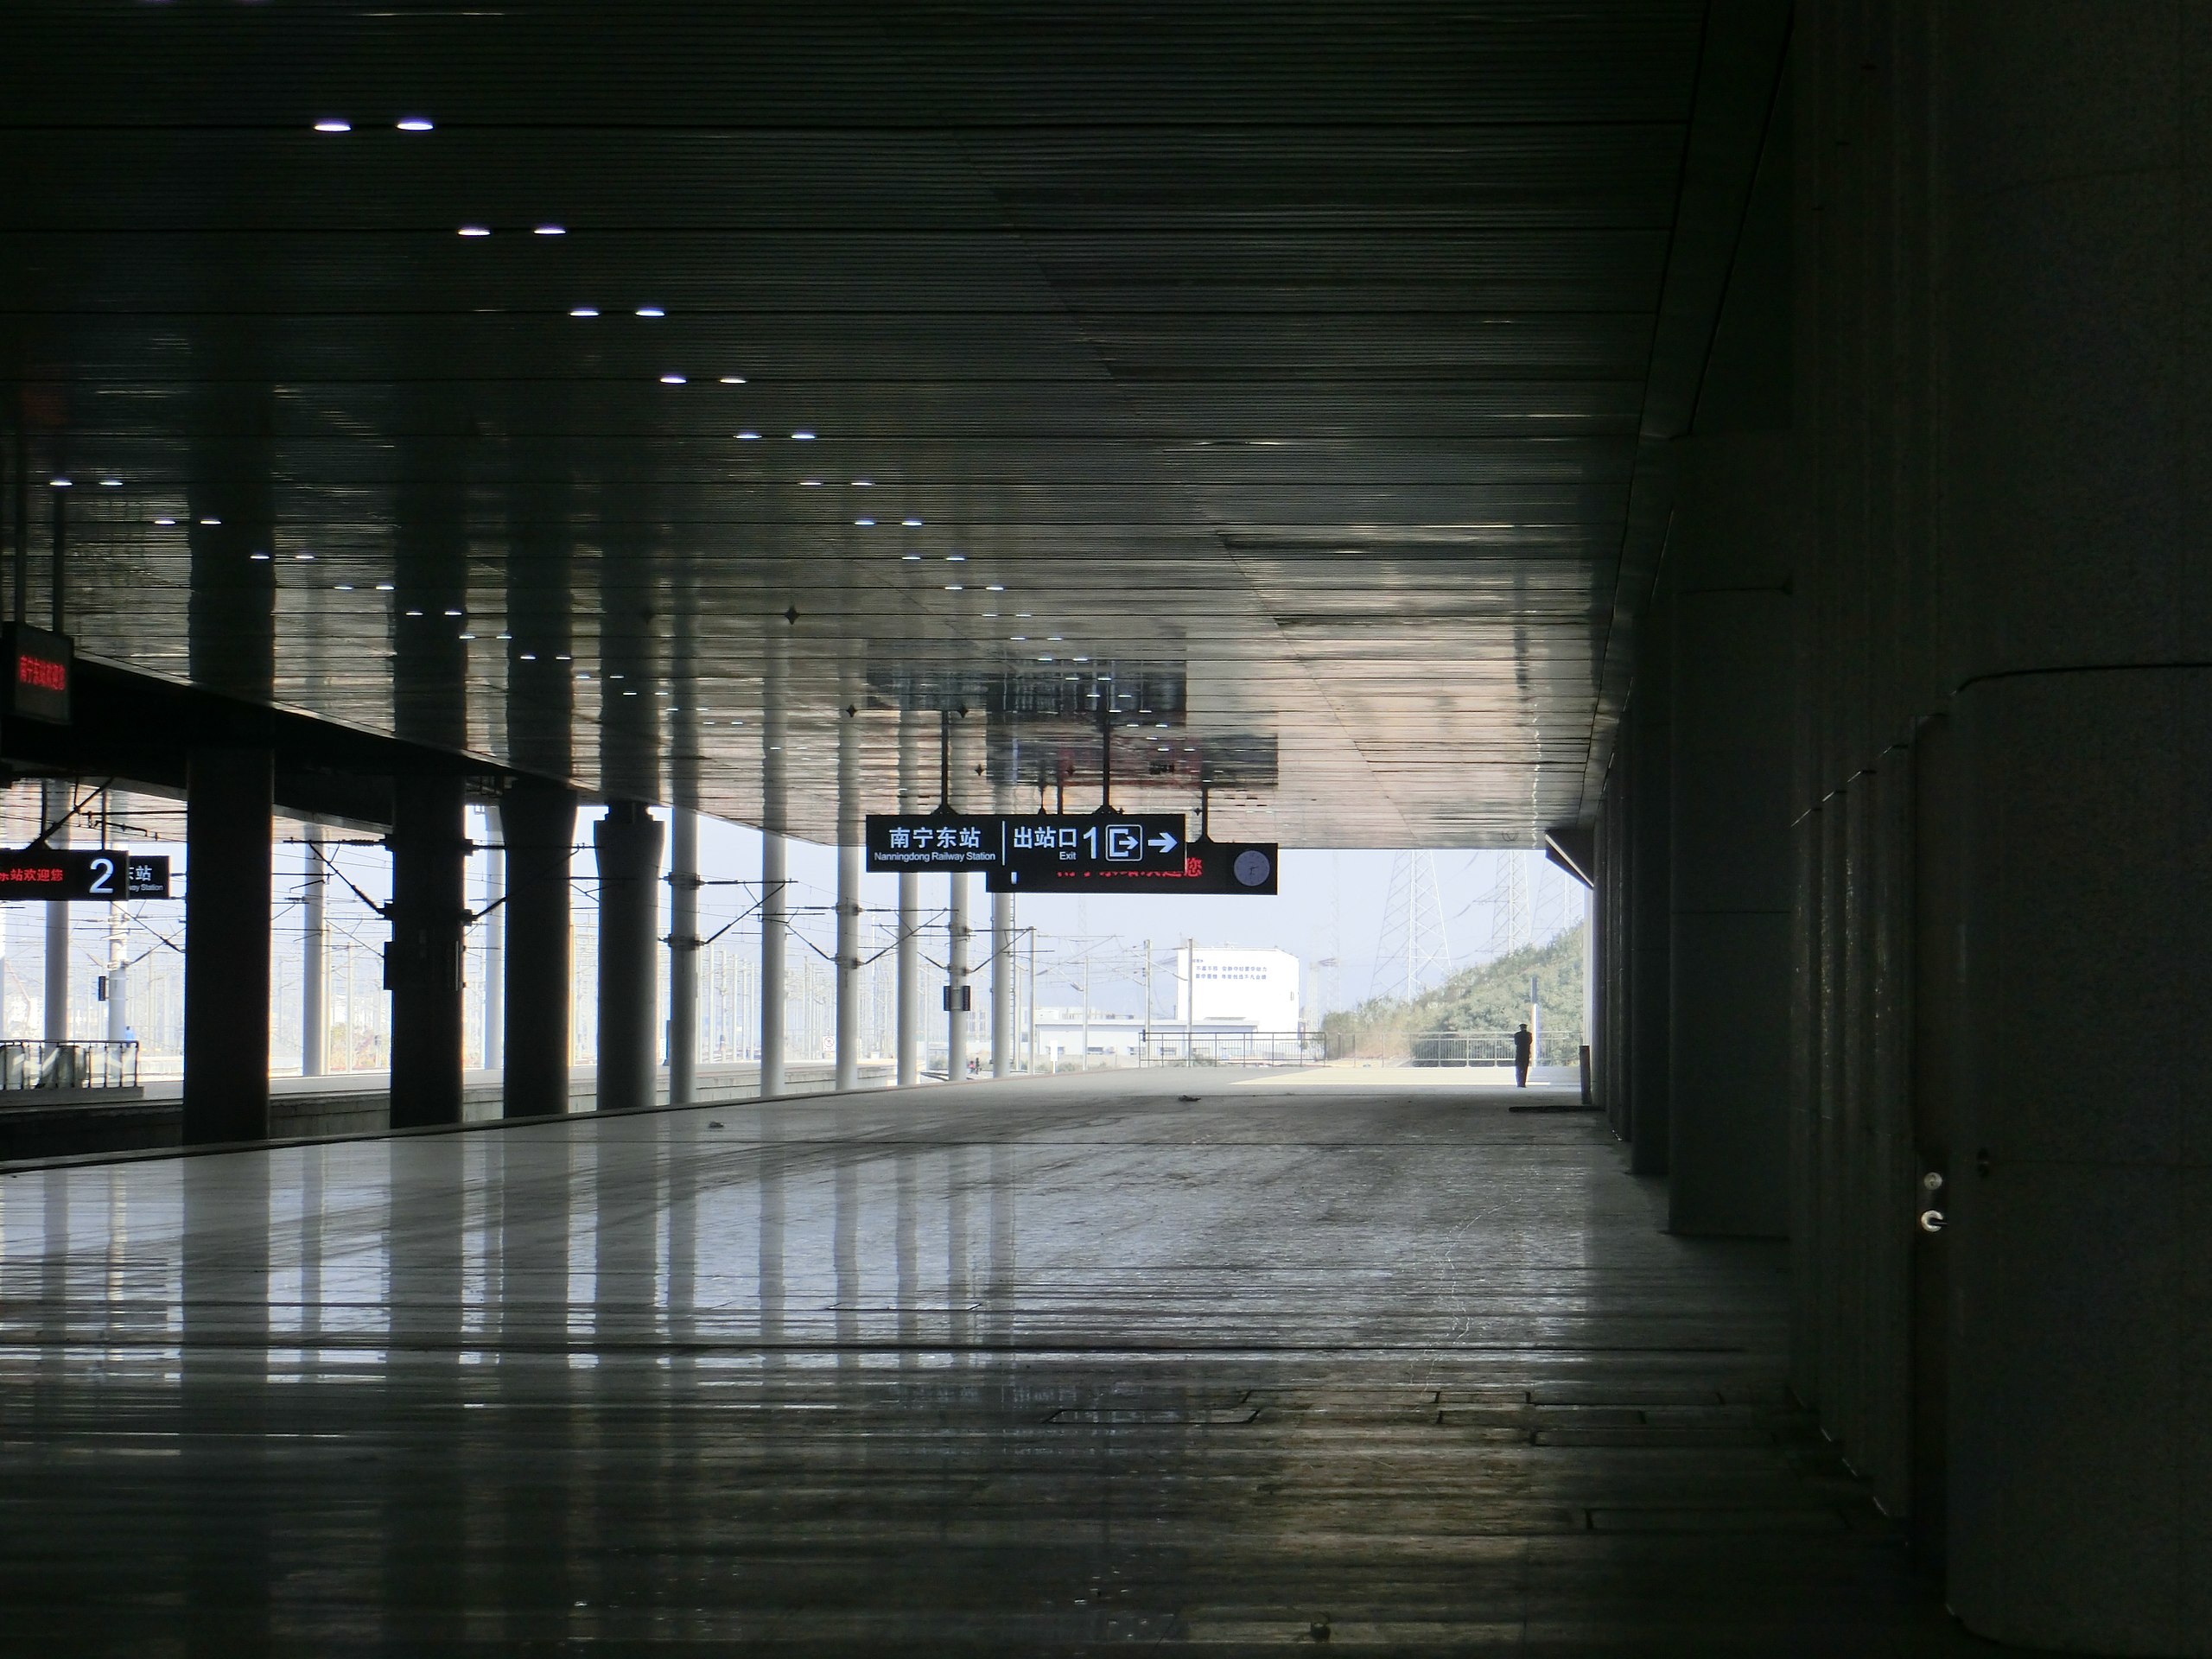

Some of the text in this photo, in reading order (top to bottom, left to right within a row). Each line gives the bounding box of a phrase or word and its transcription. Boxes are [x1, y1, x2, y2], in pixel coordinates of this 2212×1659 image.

[888, 827, 981, 848] 南宁东站
[1014, 826, 1096, 860] 出站口 1
[874, 851, 996, 862] Nanningdong Railway Station
[1059, 851, 1077, 861] Exit
[89, 858, 114, 894] 2
